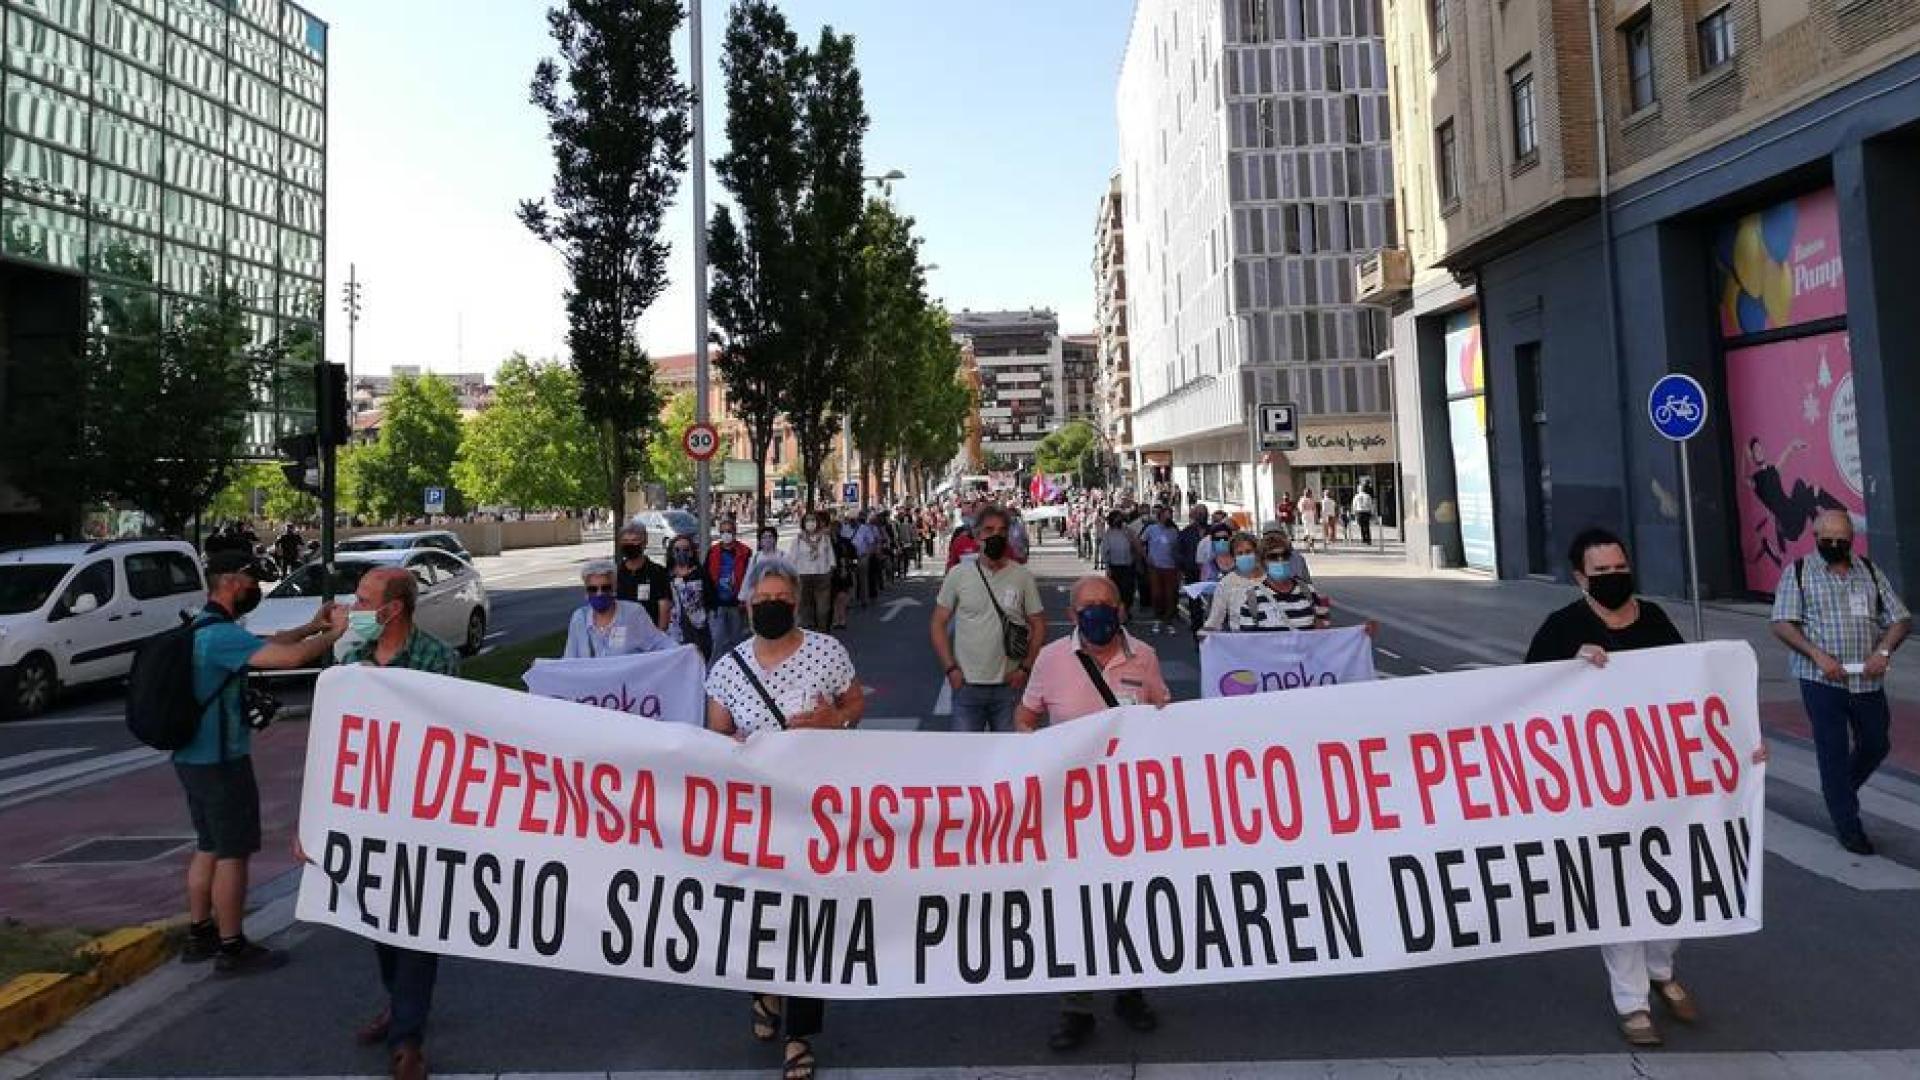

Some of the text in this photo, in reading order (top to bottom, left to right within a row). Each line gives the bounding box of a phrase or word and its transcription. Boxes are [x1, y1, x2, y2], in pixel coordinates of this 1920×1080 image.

[691, 434, 712, 447] 30
[1268, 409, 1288, 432] P
[332, 696, 1740, 876] EN DEFENSA DEL SISTEMA PÚBLICO DE PENSIONES
[323, 817, 1751, 987] PENTSIO SISTEMA PUBLIKOAREN DEFENTSAN
